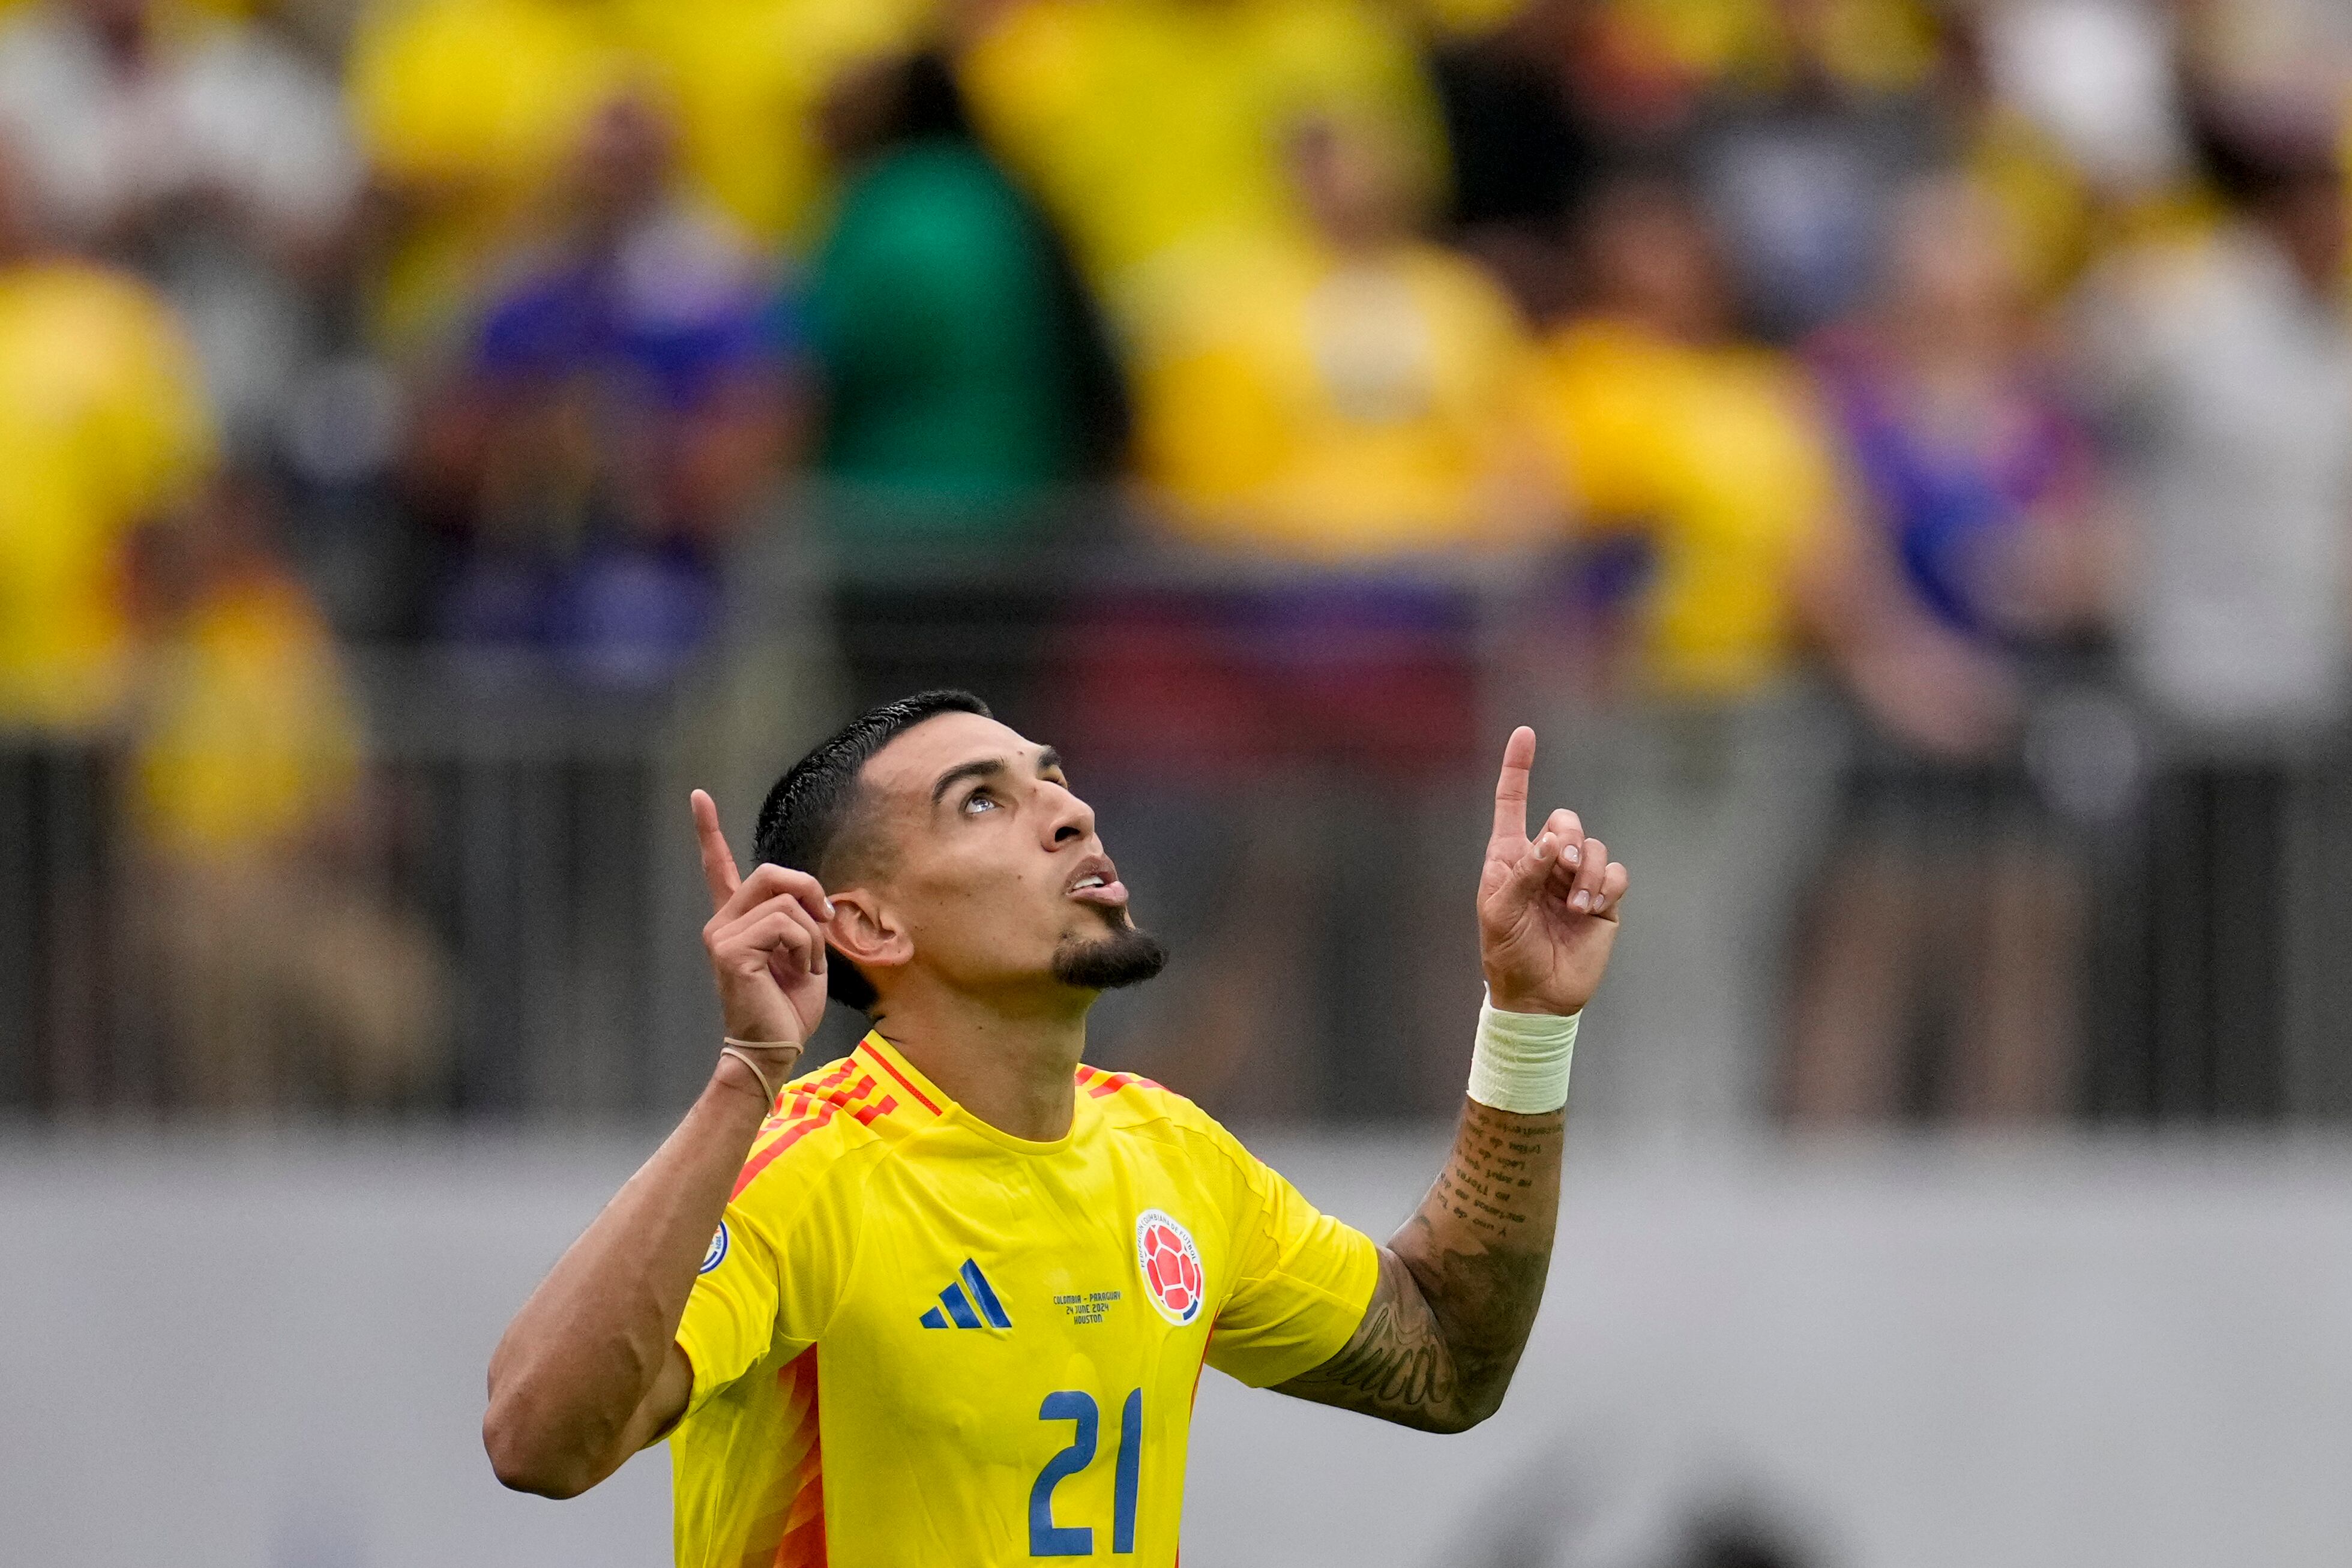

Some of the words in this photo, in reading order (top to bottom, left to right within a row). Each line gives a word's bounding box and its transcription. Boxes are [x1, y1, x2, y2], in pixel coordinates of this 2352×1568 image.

[1171, 1223, 1178, 1233] DE
[1053, 1295, 1081, 1305] COLOMBIA
[1089, 1291, 1120, 1302] PARAGUAY
[1066, 1306, 1074, 1314] 24
[1075, 1305, 1090, 1314] JUNE
[1092, 1303, 1109, 1312] 2024
[1073, 1314, 1102, 1325] HOUSTON
[1028, 1387, 1141, 1557] 21
